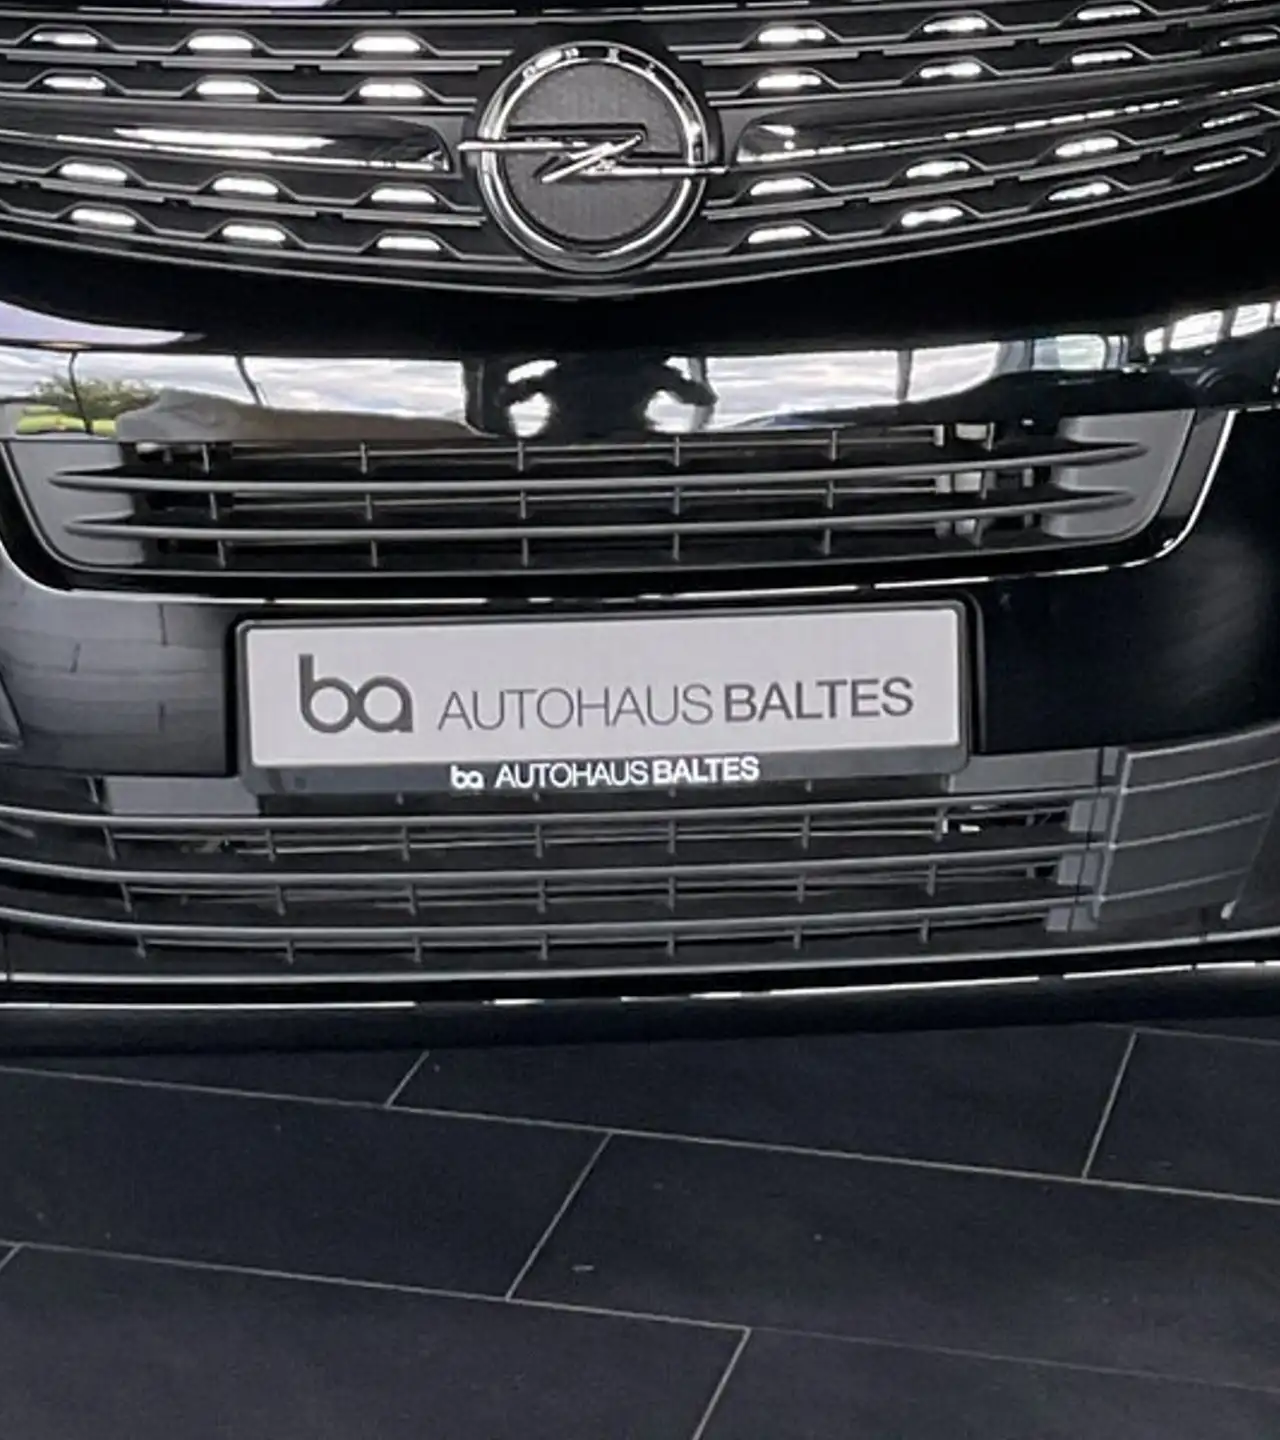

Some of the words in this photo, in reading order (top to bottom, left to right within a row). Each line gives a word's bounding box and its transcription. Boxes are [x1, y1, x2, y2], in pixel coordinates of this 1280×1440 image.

[299, 654, 413, 734] ba
[437, 684, 713, 731] AUTOHAUS
[723, 677, 914, 723] BALTES
[449, 764, 485, 790] ba
[494, 760, 649, 789] AUTOHAUS
[651, 755, 760, 784] BALTES
